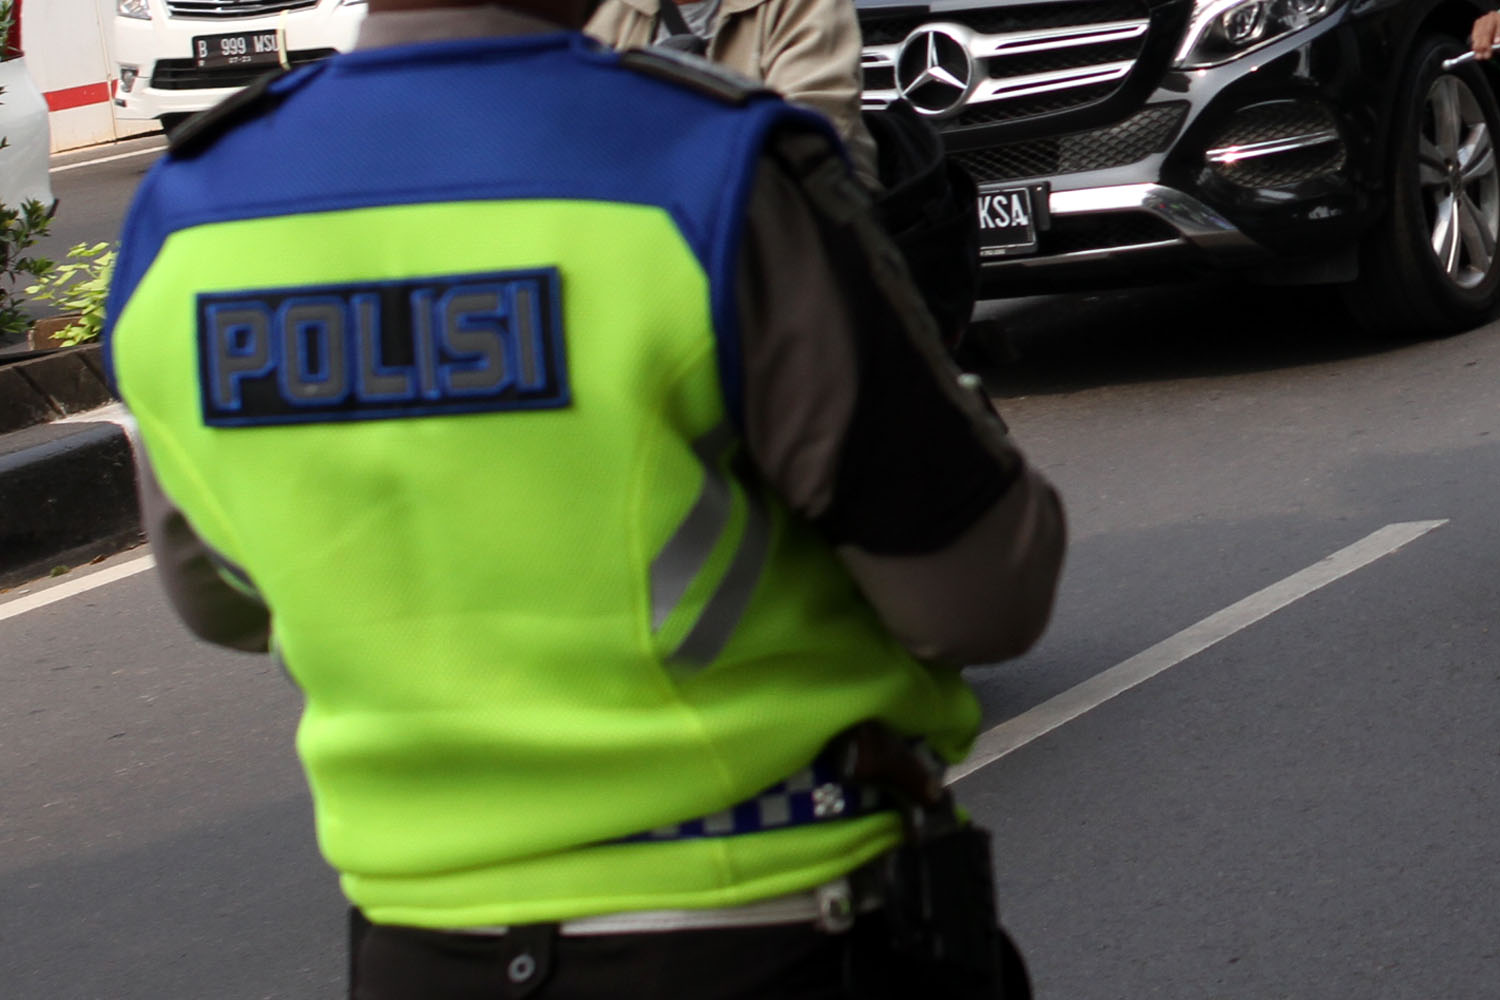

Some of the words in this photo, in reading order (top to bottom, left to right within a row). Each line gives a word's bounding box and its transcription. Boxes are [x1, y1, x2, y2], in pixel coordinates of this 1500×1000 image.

[198, 40, 208, 58] B
[221, 37, 247, 56] 999
[977, 193, 1029, 229] KSA
[205, 280, 547, 412] POLISI
